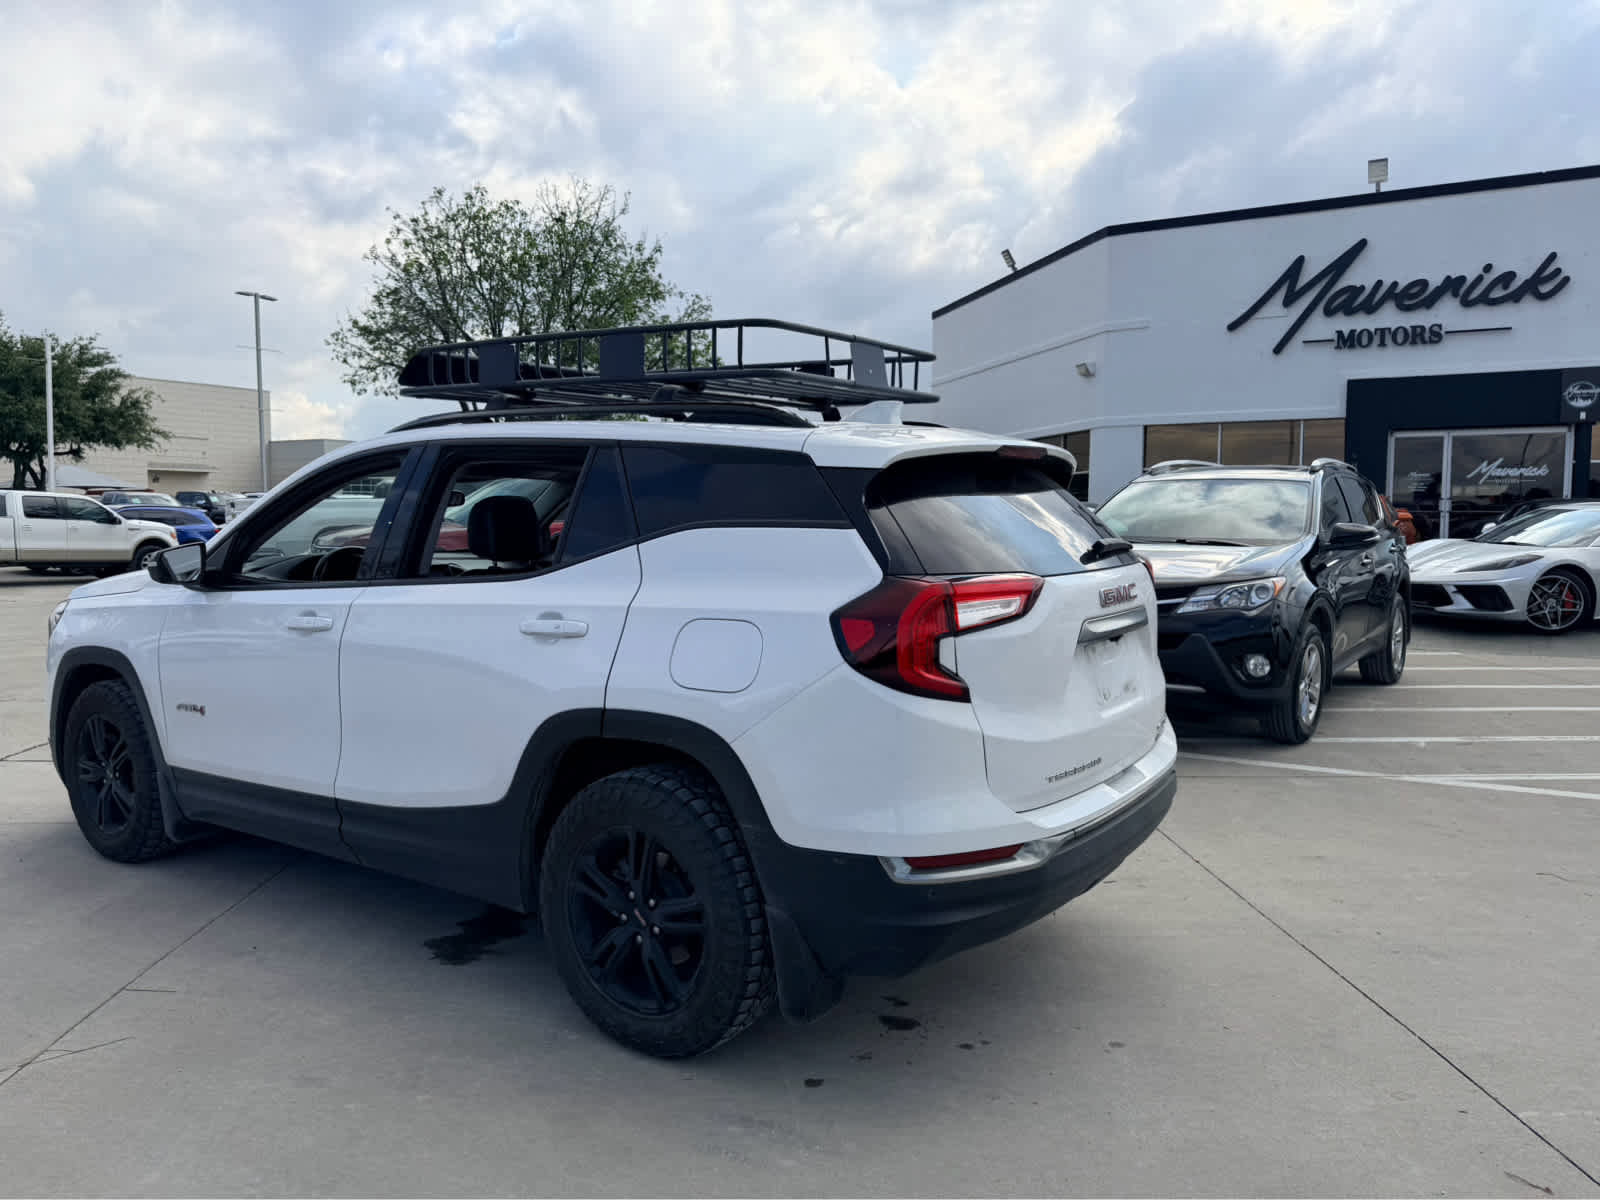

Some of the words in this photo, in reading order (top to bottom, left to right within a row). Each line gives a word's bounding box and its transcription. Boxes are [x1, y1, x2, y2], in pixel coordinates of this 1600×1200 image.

[1227, 238, 1570, 354] Maverick
[1334, 323, 1444, 350] MOTORS
[1466, 457, 1550, 485] Maverick
[1098, 583, 1138, 608] GMC
